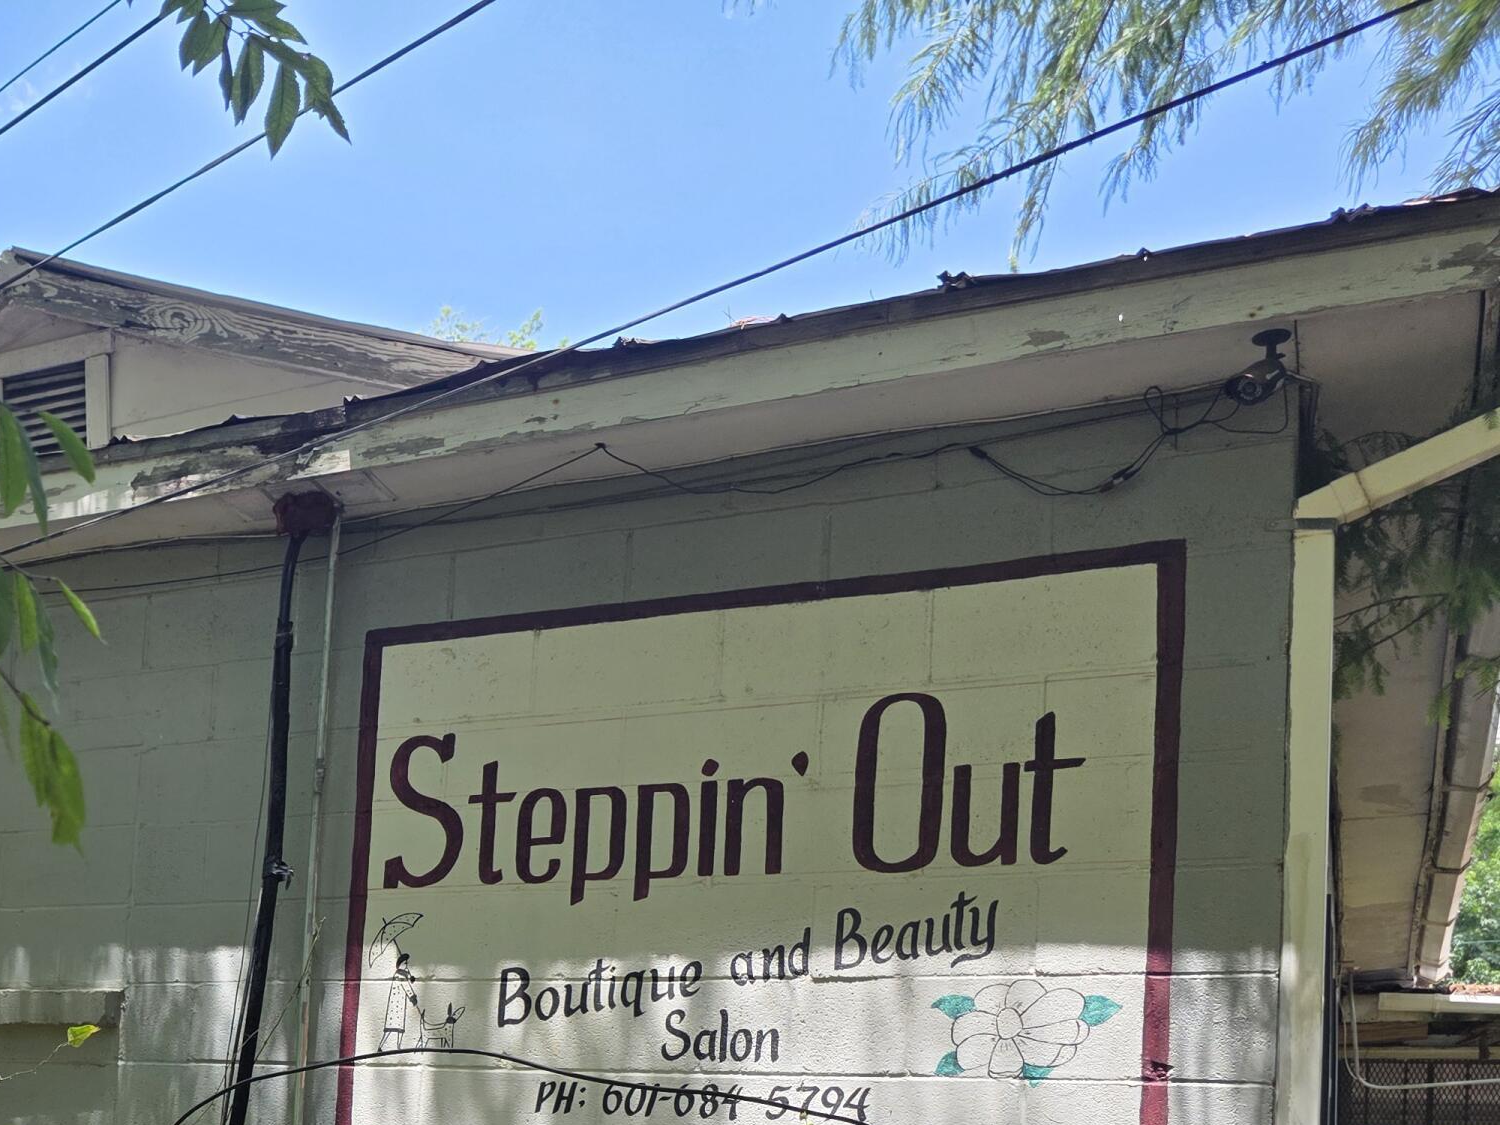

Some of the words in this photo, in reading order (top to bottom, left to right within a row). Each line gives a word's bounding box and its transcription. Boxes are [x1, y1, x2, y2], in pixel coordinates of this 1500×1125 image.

[382, 732, 810, 907] Steppin'
[852, 692, 1087, 873] Out
[497, 957, 703, 1029] Boutique
[730, 927, 811, 987] and
[833, 890, 999, 970] Beauty
[660, 1008, 780, 1063] Salon
[534, 1081, 587, 1115] PH:
[601, 1083, 872, 1122] 601-6845794
